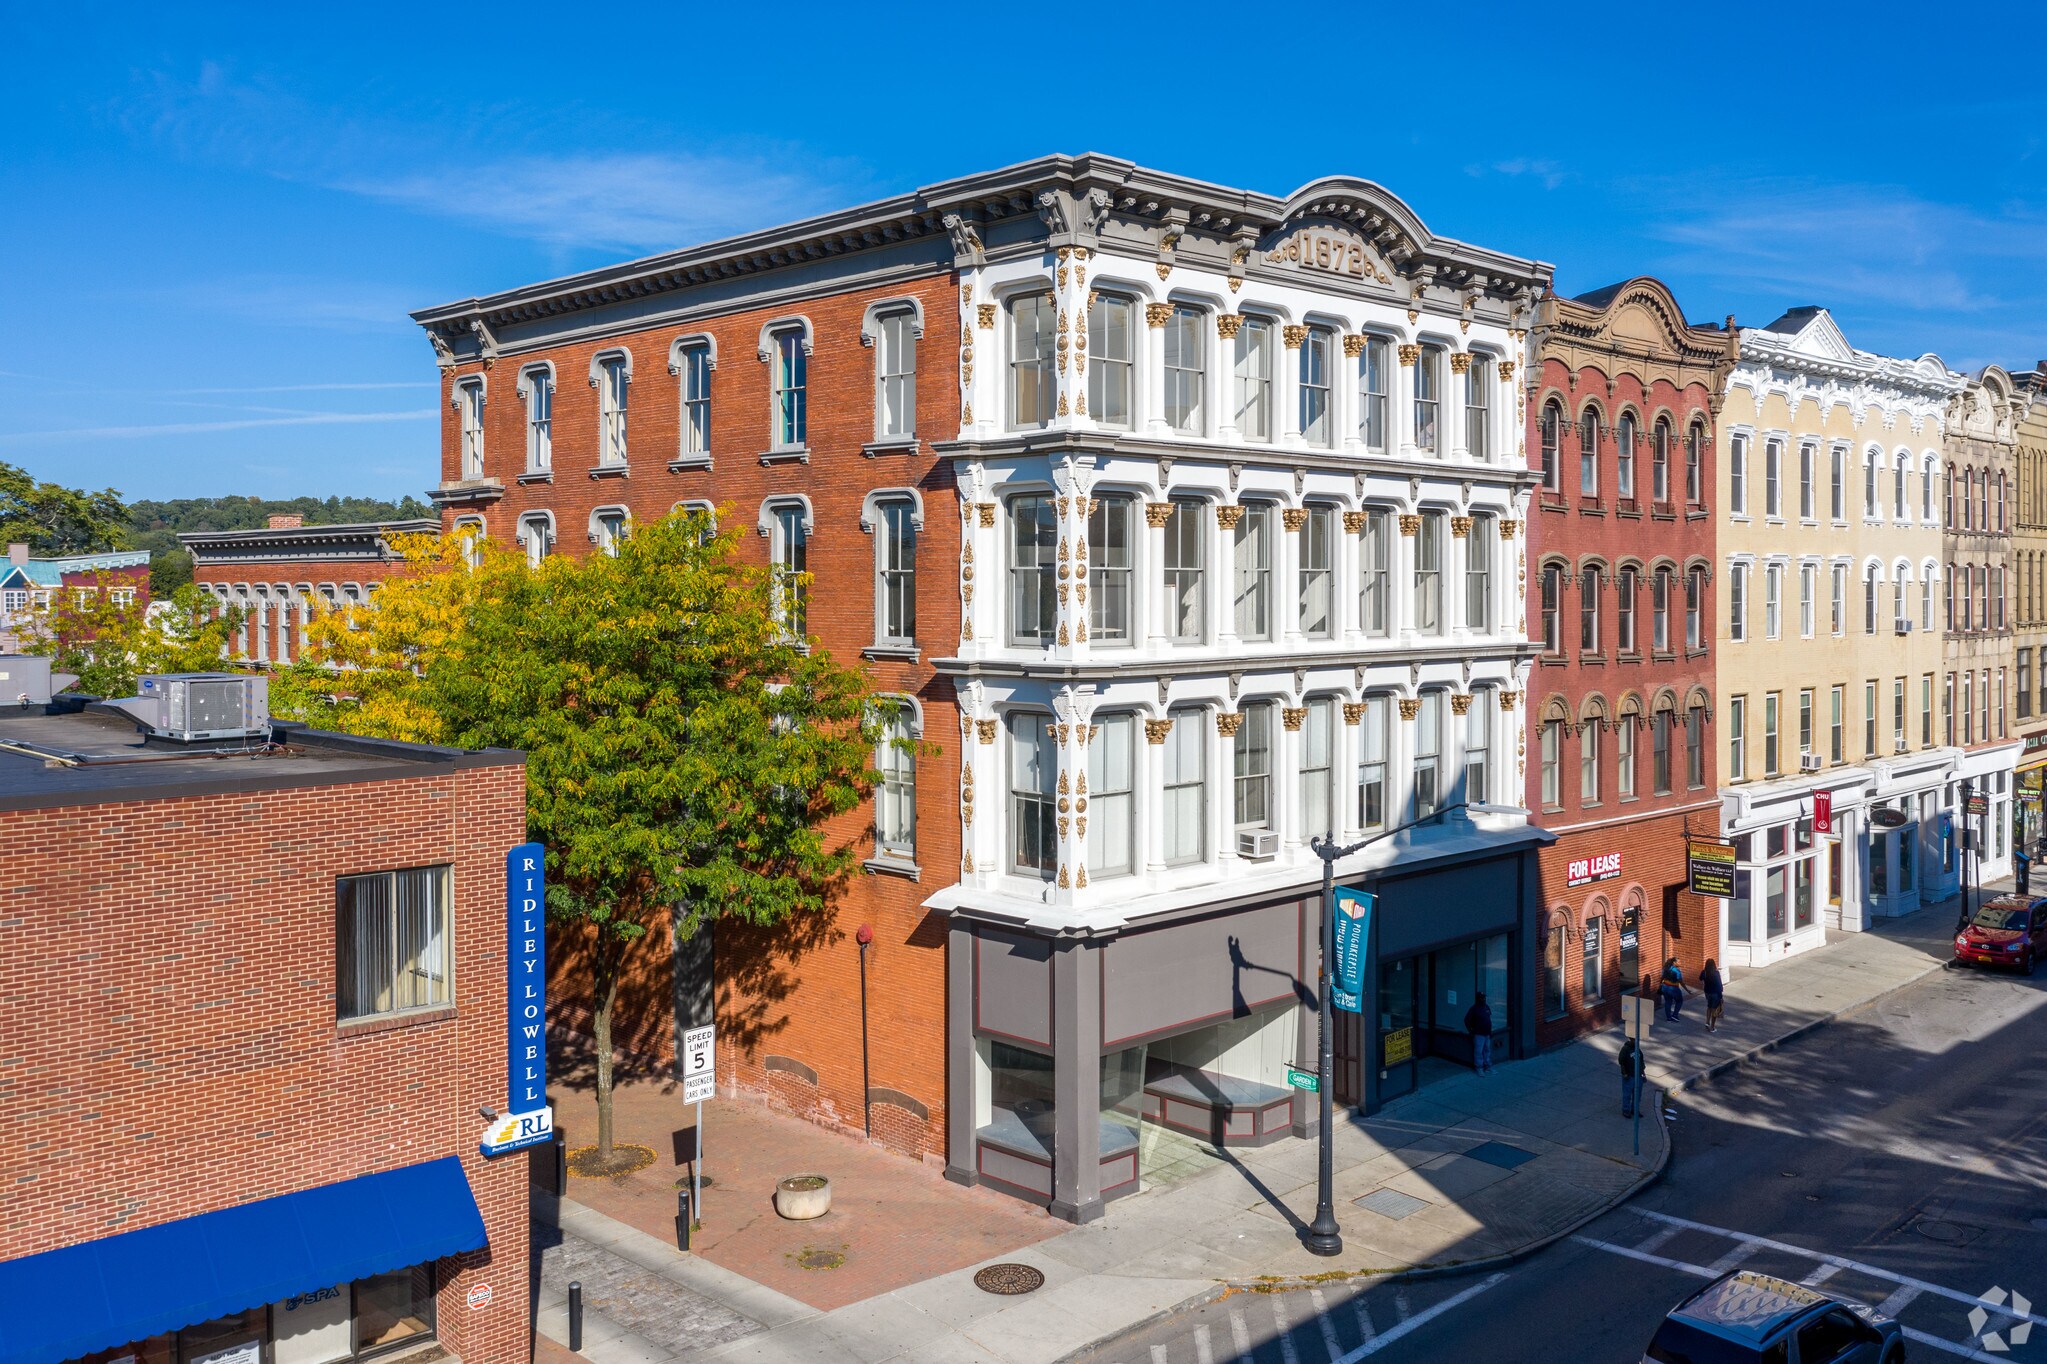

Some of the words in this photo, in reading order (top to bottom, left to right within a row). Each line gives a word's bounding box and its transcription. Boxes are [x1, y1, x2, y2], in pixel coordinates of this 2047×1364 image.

[1303, 233, 1363, 276] 1872
[1568, 860, 1588, 879] FOR
[1590, 853, 1620, 874] LEASE
[523, 858, 536, 973] RIDLEY
[1346, 922, 1361, 979] POUGHKEEPSIE
[523, 985, 540, 1101] LOWELL
[687, 1031, 712, 1043] SPEED
[1386, 1034, 1395, 1044] FOR
[1395, 1028, 1410, 1041] LEASE
[689, 1040, 709, 1052] LIMIT
[694, 1052, 705, 1069] 5
[686, 1075, 712, 1089] PASSENGER
[1292, 1074, 1311, 1086] GARDEN
[686, 1090, 698, 1100] CARS
[700, 1086, 712, 1097] ONLY
[520, 1114, 550, 1137] RL
[304, 1286, 339, 1304] SPA
[210, 1348, 240, 1361] NOTICE
